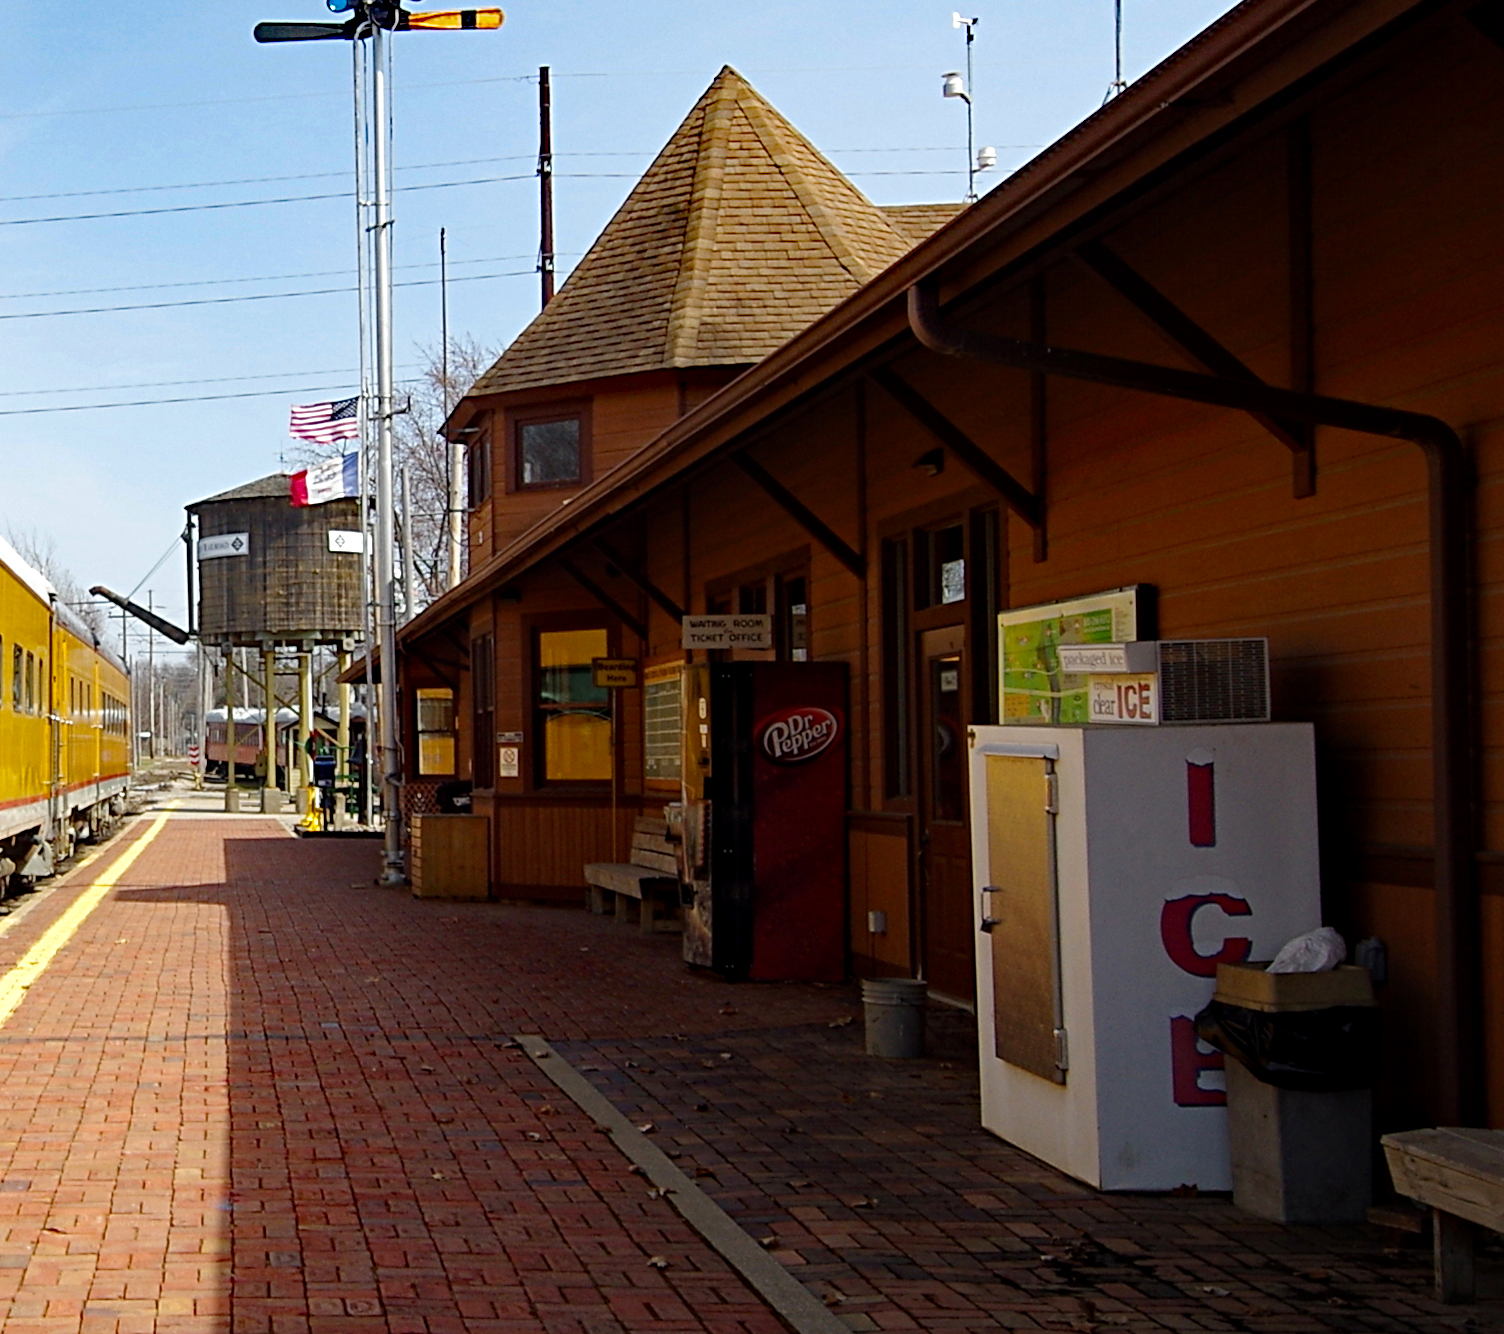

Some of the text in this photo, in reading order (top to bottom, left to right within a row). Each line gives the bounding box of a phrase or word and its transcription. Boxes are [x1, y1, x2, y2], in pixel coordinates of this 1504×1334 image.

[689, 618, 764, 628] WAITING ROOM
[690, 633, 763, 643] TICKET OFFICE
[597, 662, 638, 673] Boarding
[1063, 652, 1123, 669] packaged ice
[1093, 682, 1152, 719] clear ICE
[787, 714, 814, 737] Dr
[763, 719, 832, 758] Pepper
